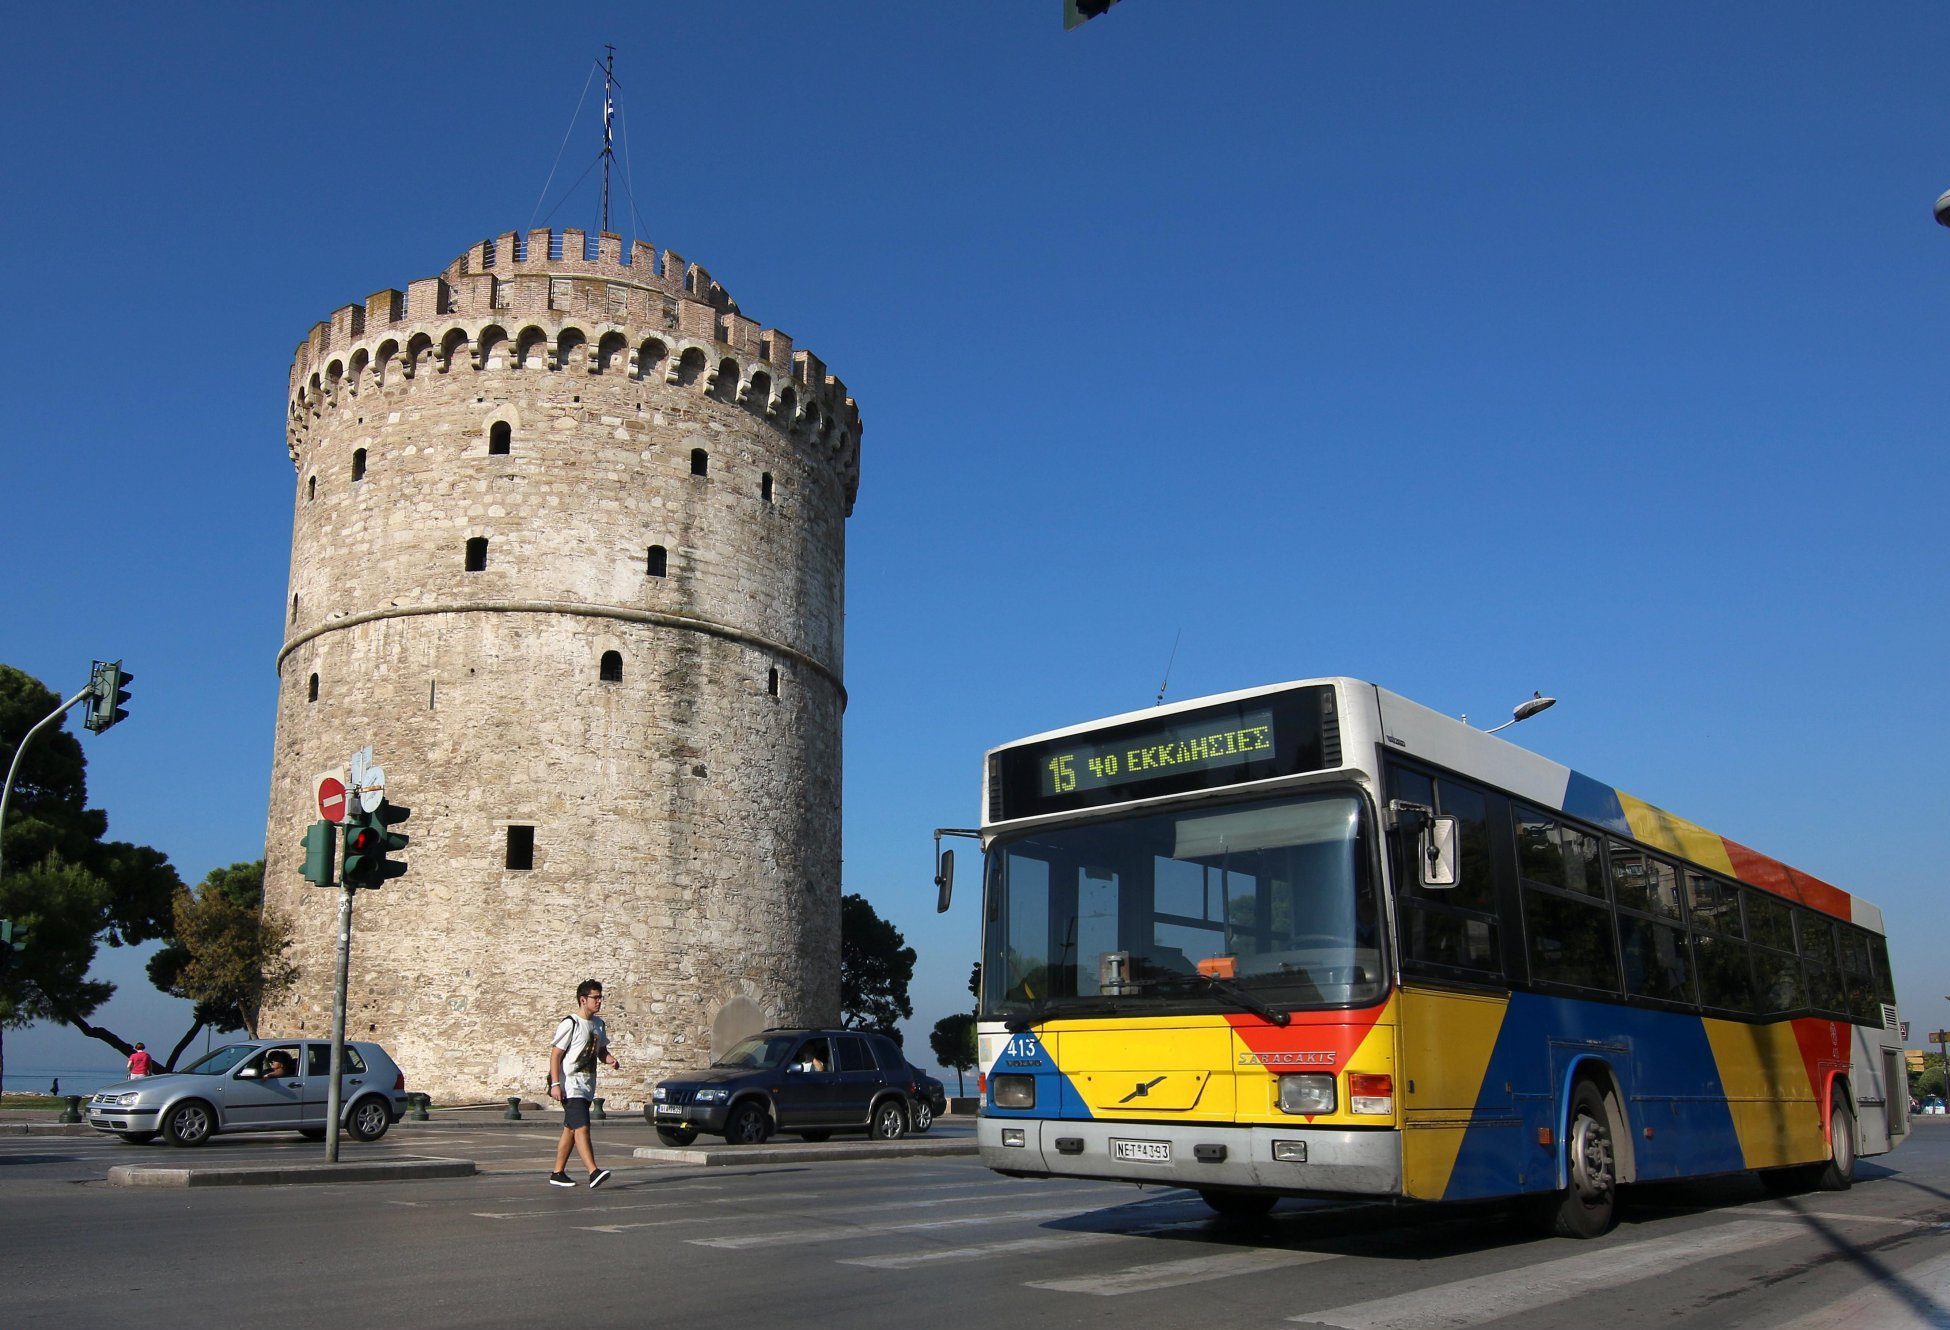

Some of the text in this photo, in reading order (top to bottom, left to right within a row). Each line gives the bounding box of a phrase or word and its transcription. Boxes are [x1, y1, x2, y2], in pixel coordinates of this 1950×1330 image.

[1048, 725, 1270, 793] 15 40 ΕΚΚΛΗΣΙΕΣ
[1007, 1038, 1036, 1057] 413
[1238, 1052, 1336, 1065] SARACAKIS
